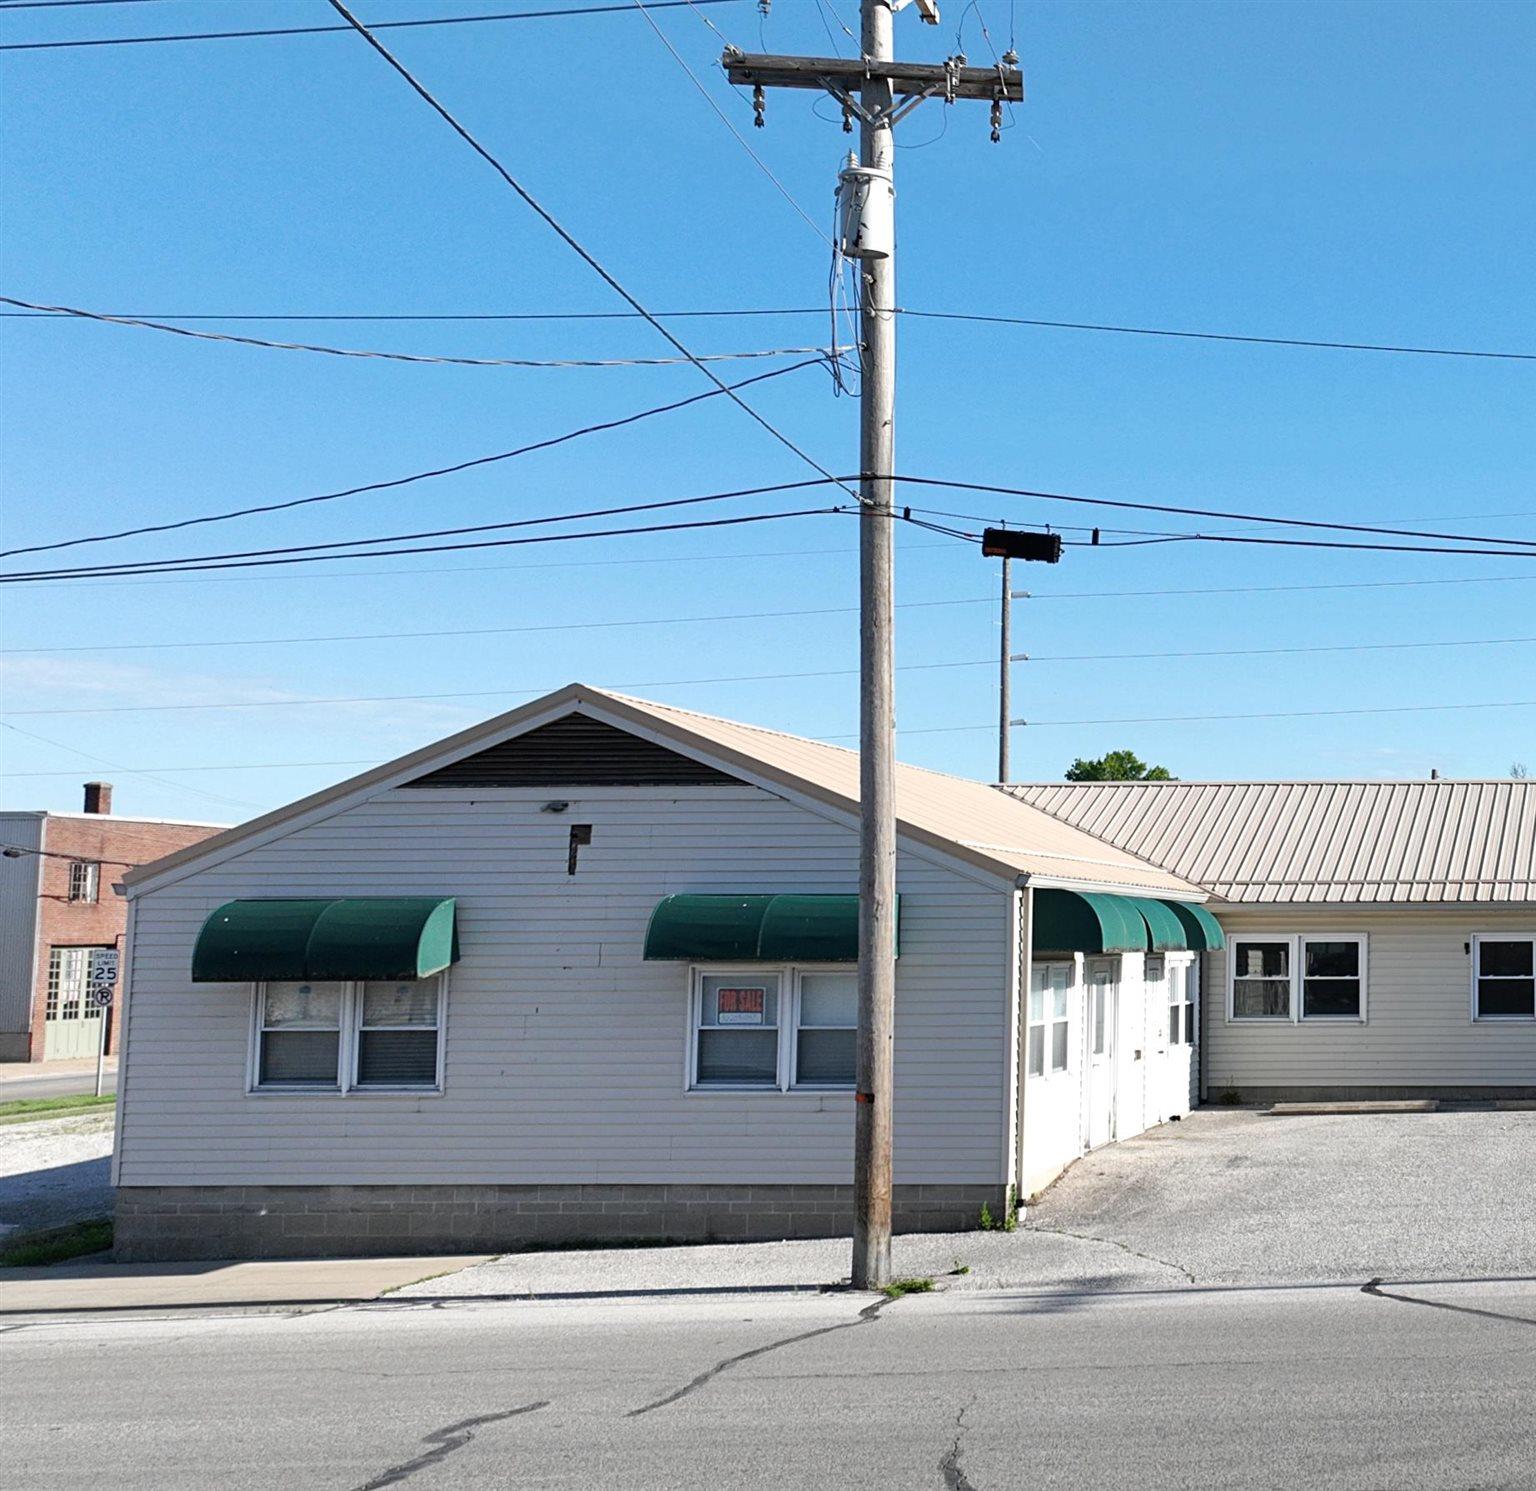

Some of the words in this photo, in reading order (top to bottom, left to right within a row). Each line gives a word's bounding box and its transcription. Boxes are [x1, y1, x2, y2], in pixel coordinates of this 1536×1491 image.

[95, 967, 117, 980] 25
[720, 990, 737, 1011] FOR
[739, 990, 762, 1011] SALE
